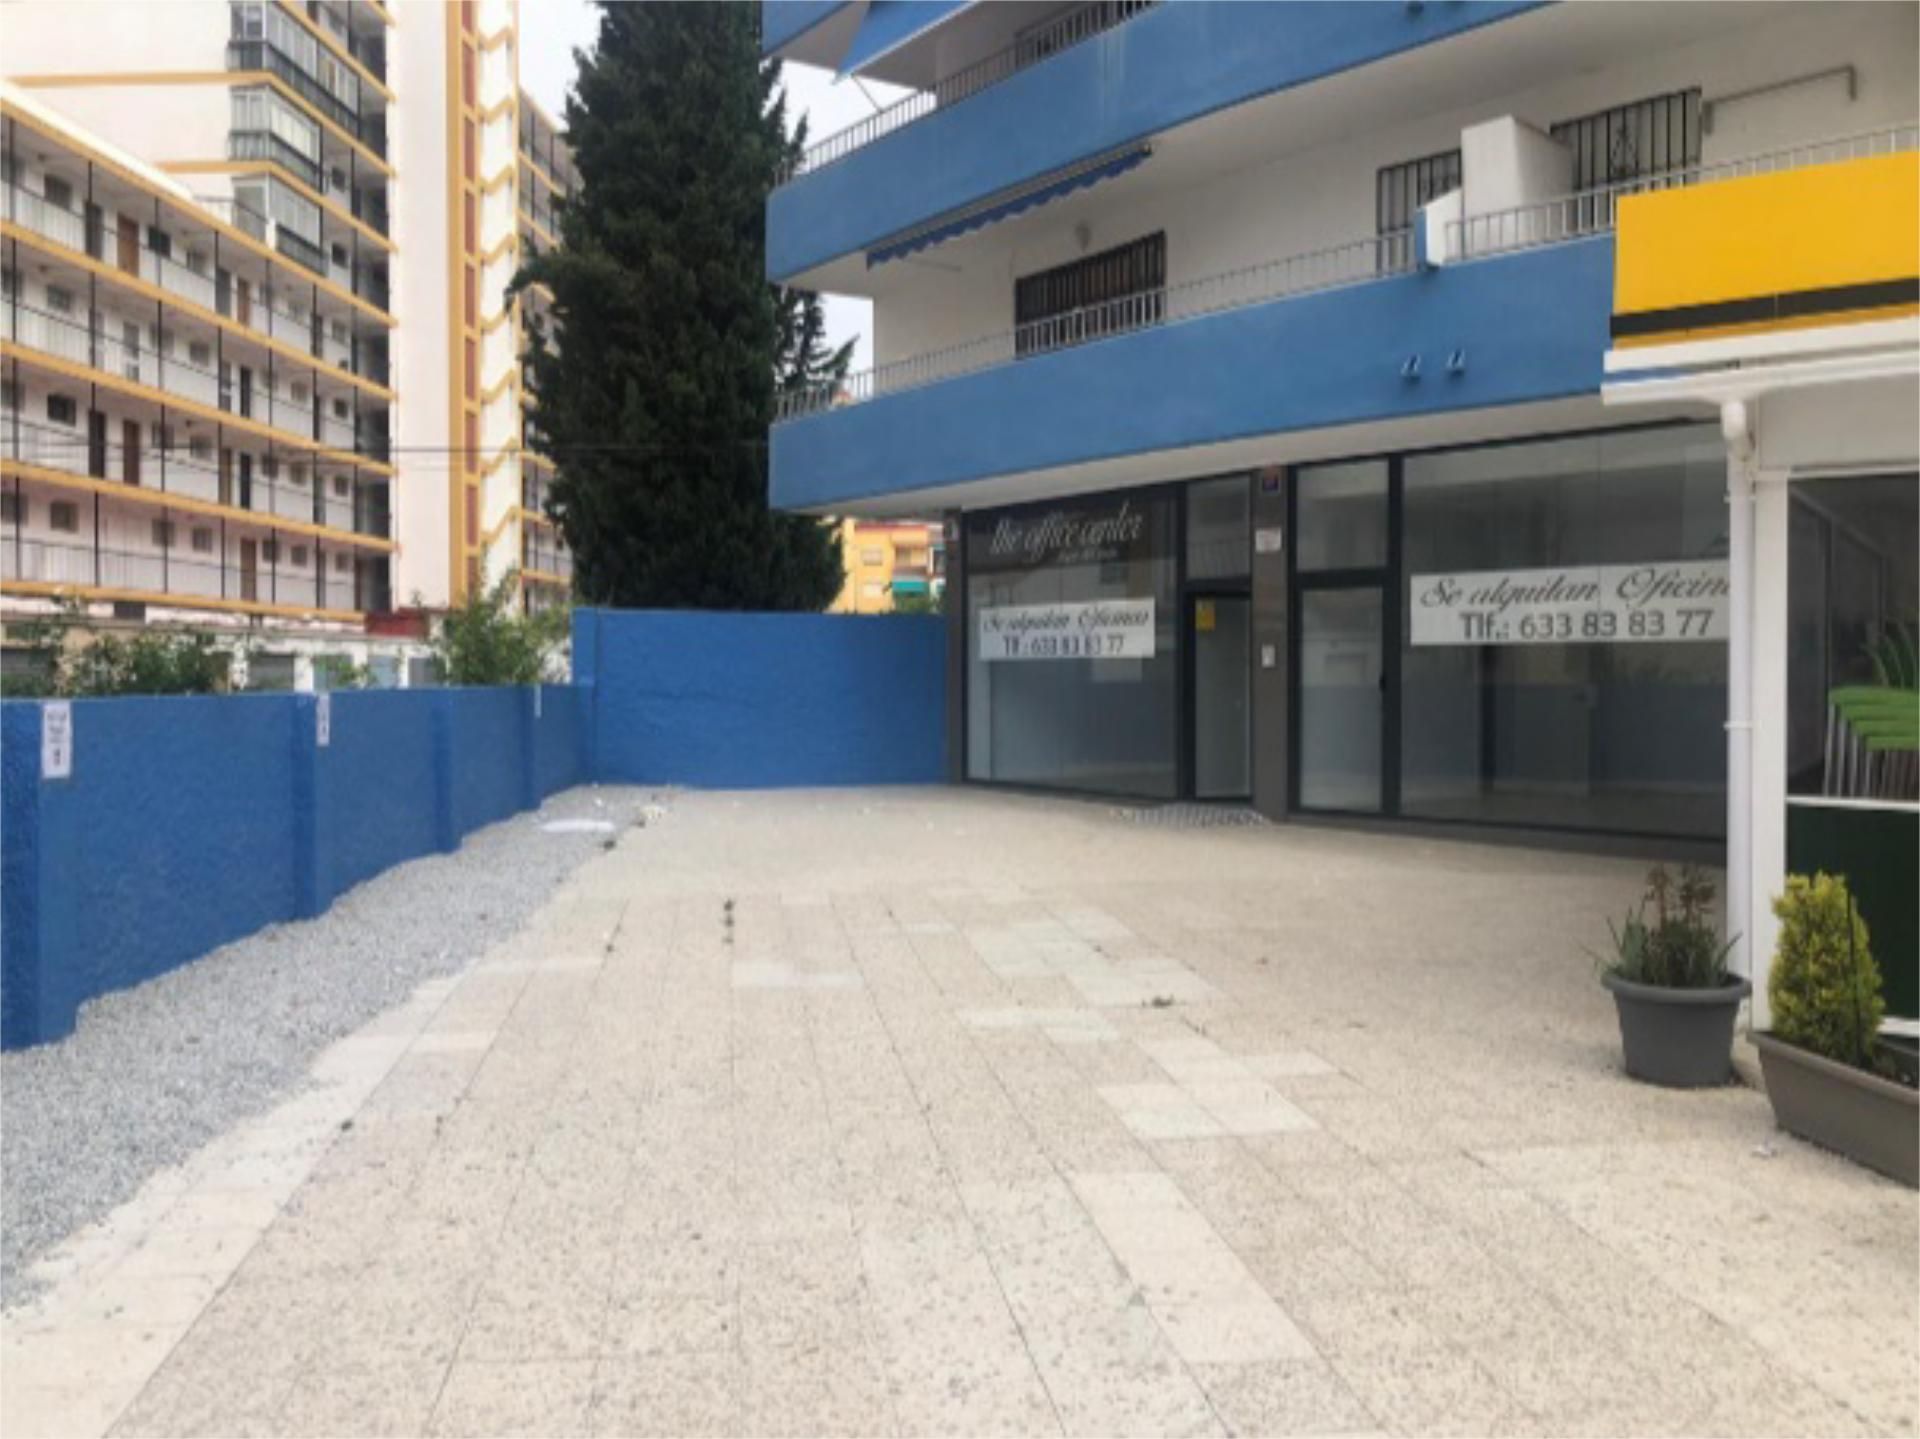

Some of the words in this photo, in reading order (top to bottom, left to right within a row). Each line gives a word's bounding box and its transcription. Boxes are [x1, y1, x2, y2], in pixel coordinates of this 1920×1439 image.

[1420, 577, 1463, 608] Se
[1470, 574, 1599, 613] alquilan
[1616, 567, 1729, 608] Oficin
[1519, 612, 1573, 640] 633
[1581, 611, 1617, 638] 83
[1628, 610, 1665, 637] 83
[1676, 609, 1715, 637] 77
